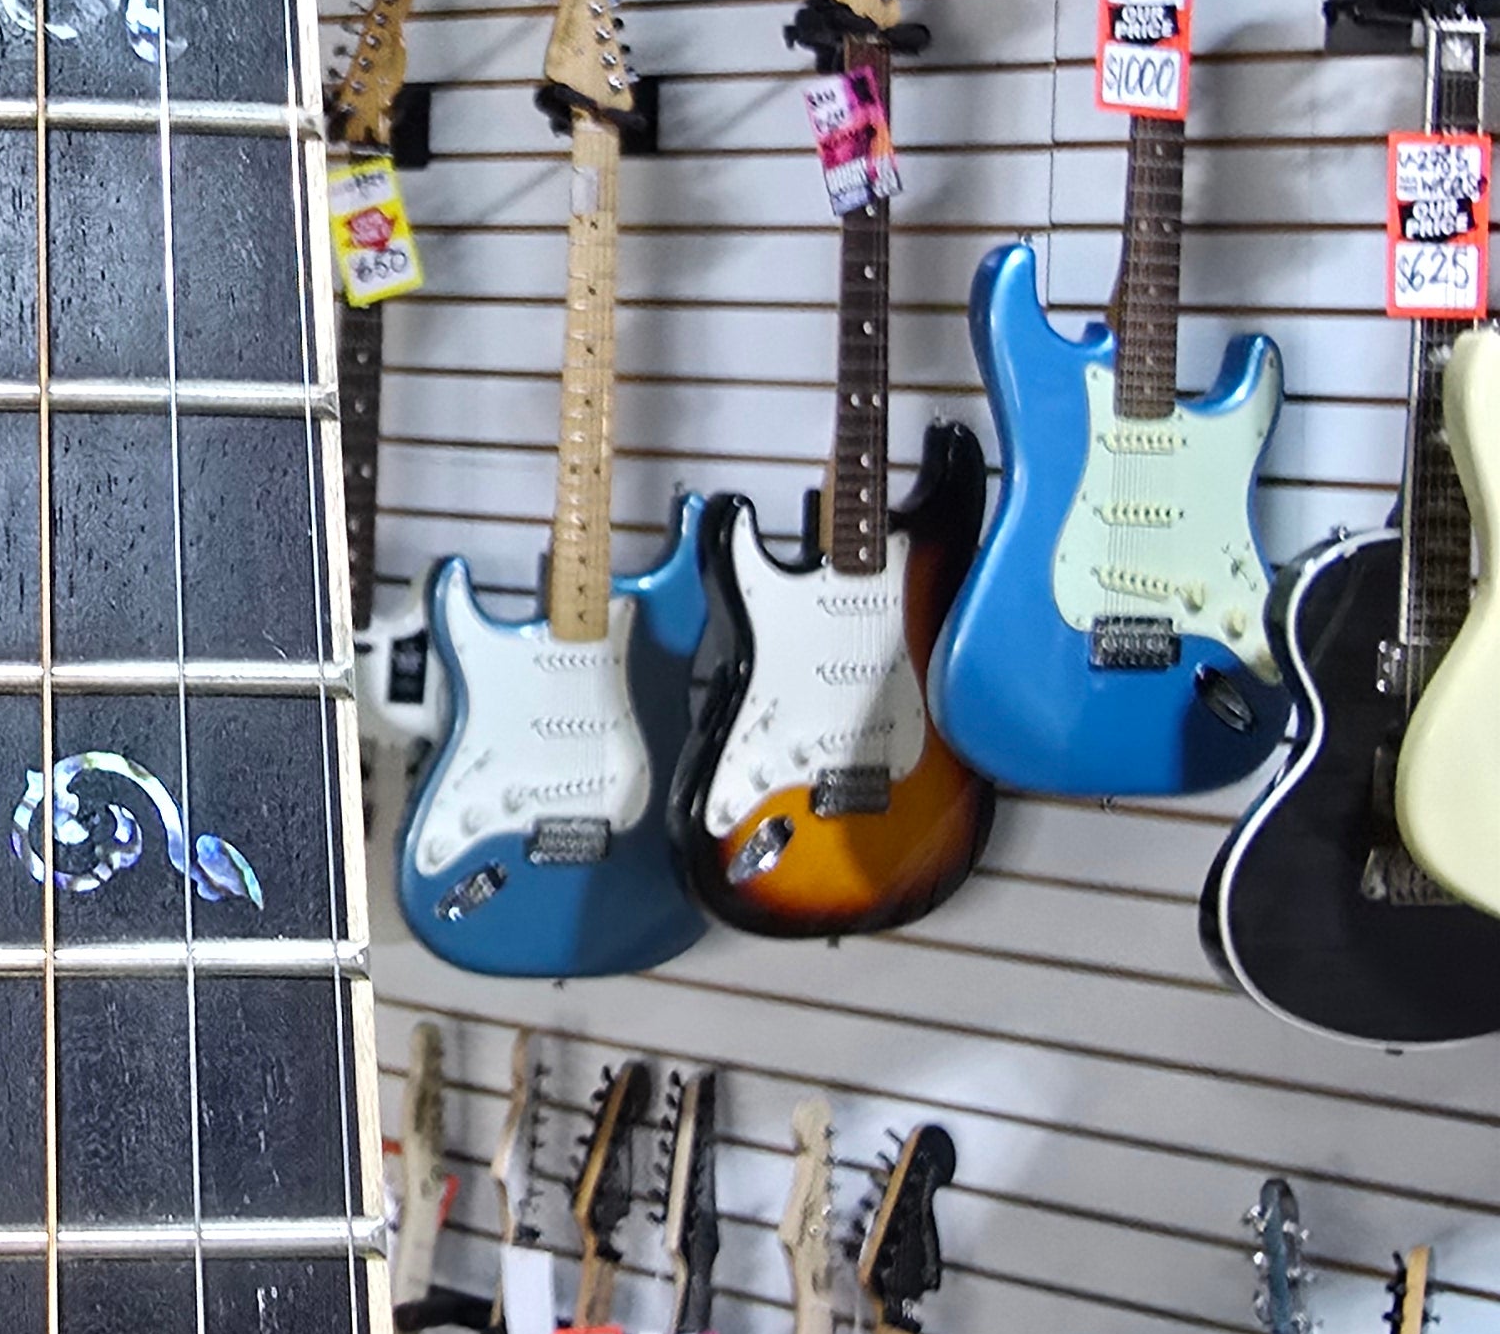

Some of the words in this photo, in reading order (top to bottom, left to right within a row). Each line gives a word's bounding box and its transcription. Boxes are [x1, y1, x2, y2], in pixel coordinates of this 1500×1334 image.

[1113, 18, 1175, 41] PRICE
[1105, 52, 1176, 101] $1000
[1411, 200, 1459, 221] OUR
[1405, 213, 1469, 239] PRICE
[1398, 244, 1470, 294] $625
